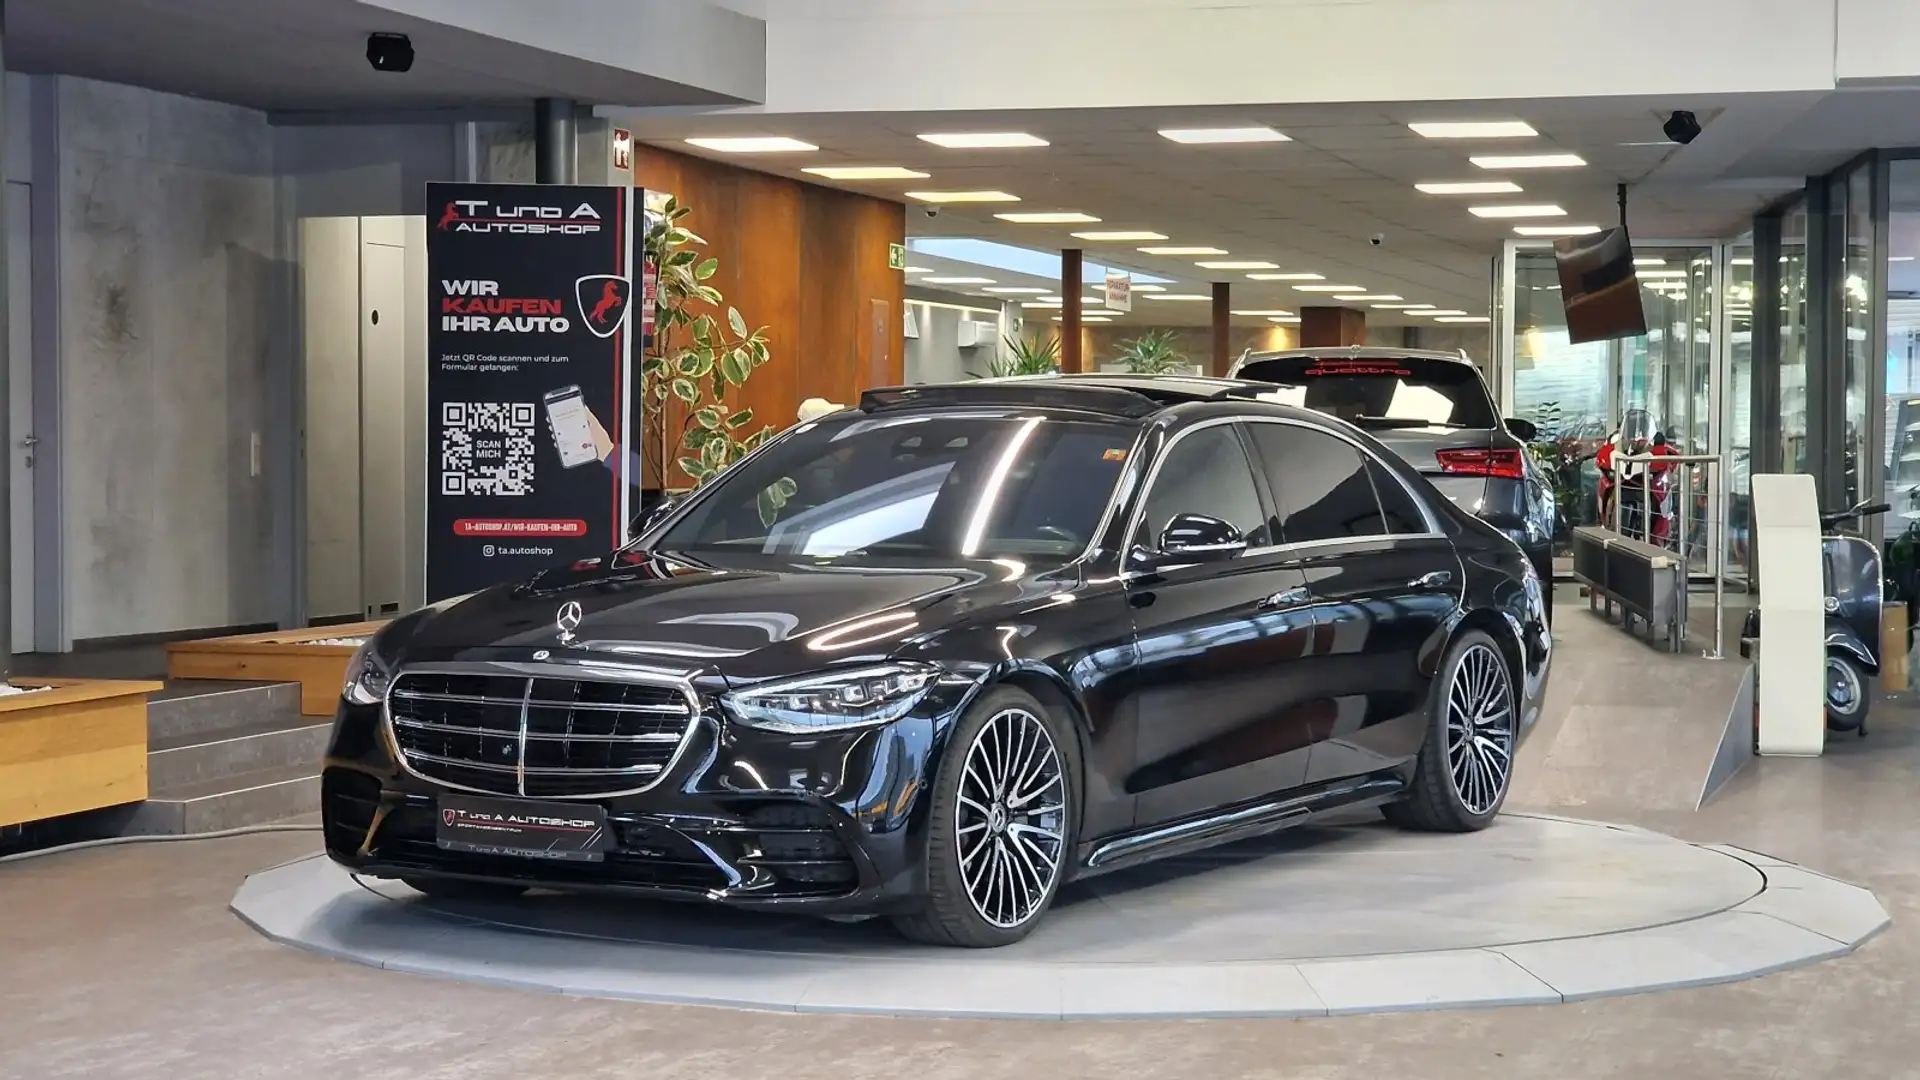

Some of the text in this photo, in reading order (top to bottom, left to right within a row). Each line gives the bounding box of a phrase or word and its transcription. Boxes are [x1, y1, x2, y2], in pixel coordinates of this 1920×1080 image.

[455, 200, 489, 216] T
[569, 203, 601, 219] A
[455, 223, 600, 234] AUTOSHOP
[442, 280, 498, 296] WIR
[442, 298, 562, 315] KAUFEN
[442, 316, 570, 333] IHR AUTO
[442, 354, 460, 363] Jetzt
[462, 354, 475, 363] QR
[477, 354, 497, 363] Code
[499, 355, 533, 363] scannen
[534, 355, 550, 363] und
[442, 363, 478, 371] Formular
[1305, 367, 1411, 375] quattro
[476, 440, 501, 449] SCAN
[476, 450, 501, 459] MICH
[498, 546, 553, 556] ta.autoshop
[457, 809, 467, 817] T
[508, 815, 595, 827] AUTOSHOP
[503, 848, 567, 859] AUTOSHOP
